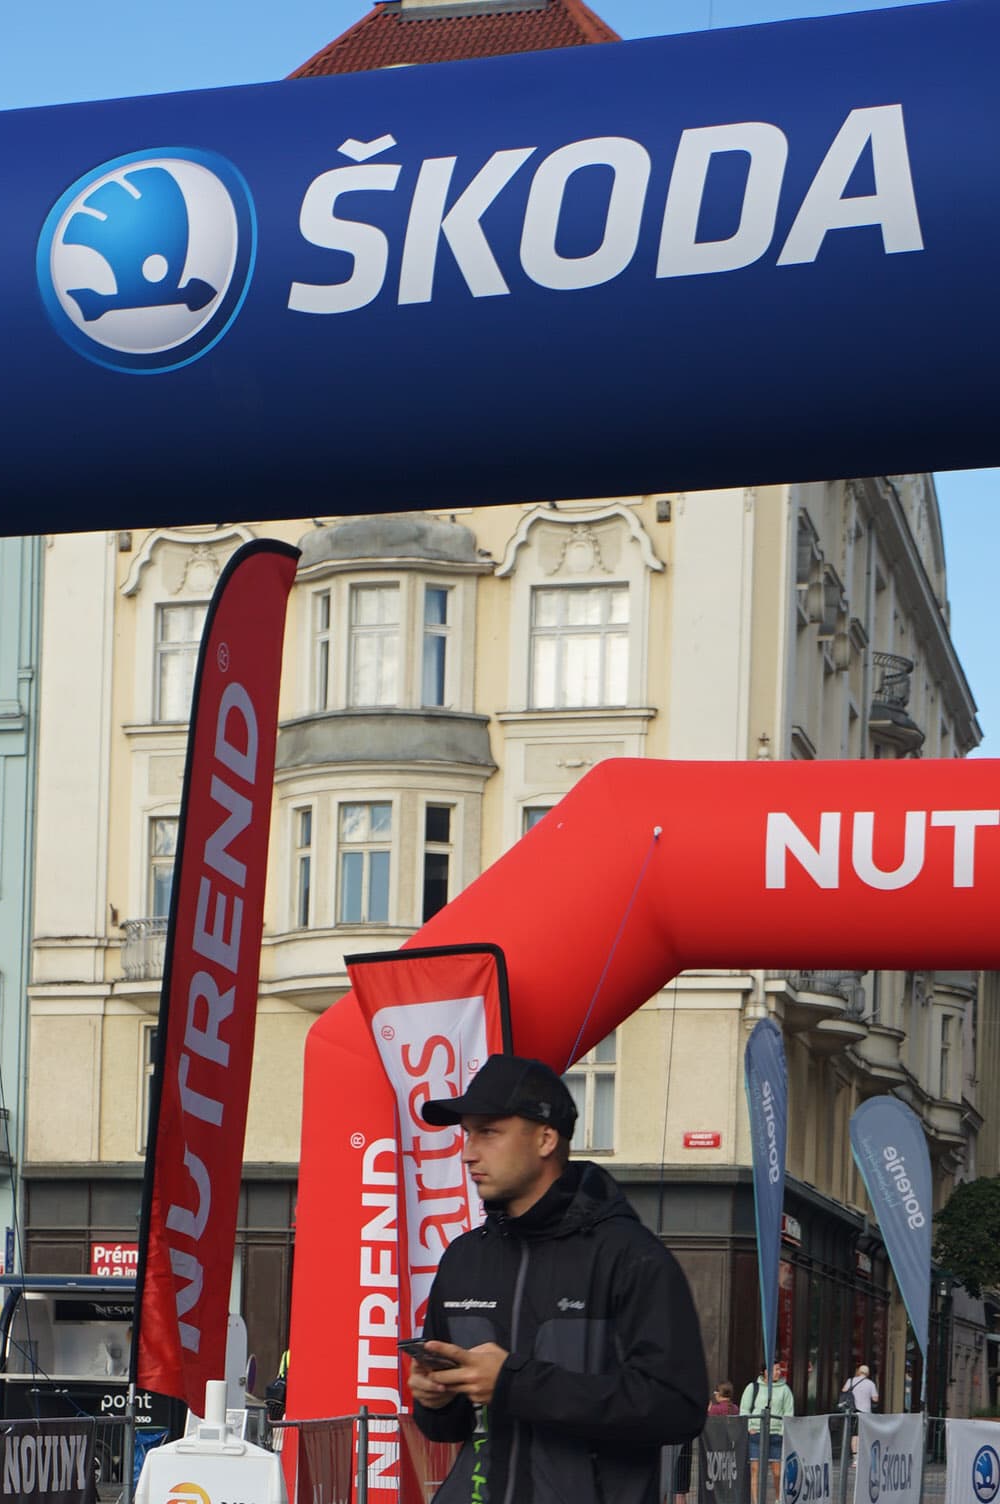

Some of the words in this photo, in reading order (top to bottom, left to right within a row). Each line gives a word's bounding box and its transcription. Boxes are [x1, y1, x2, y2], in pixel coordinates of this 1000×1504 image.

[288, 104, 925, 316] ŠKODA
[765, 810, 1000, 891] NUT
[164, 682, 259, 1354] NUTREND
[3, 1434, 88, 1495] NOVINY
[881, 1447, 913, 1492] ŠKODA
